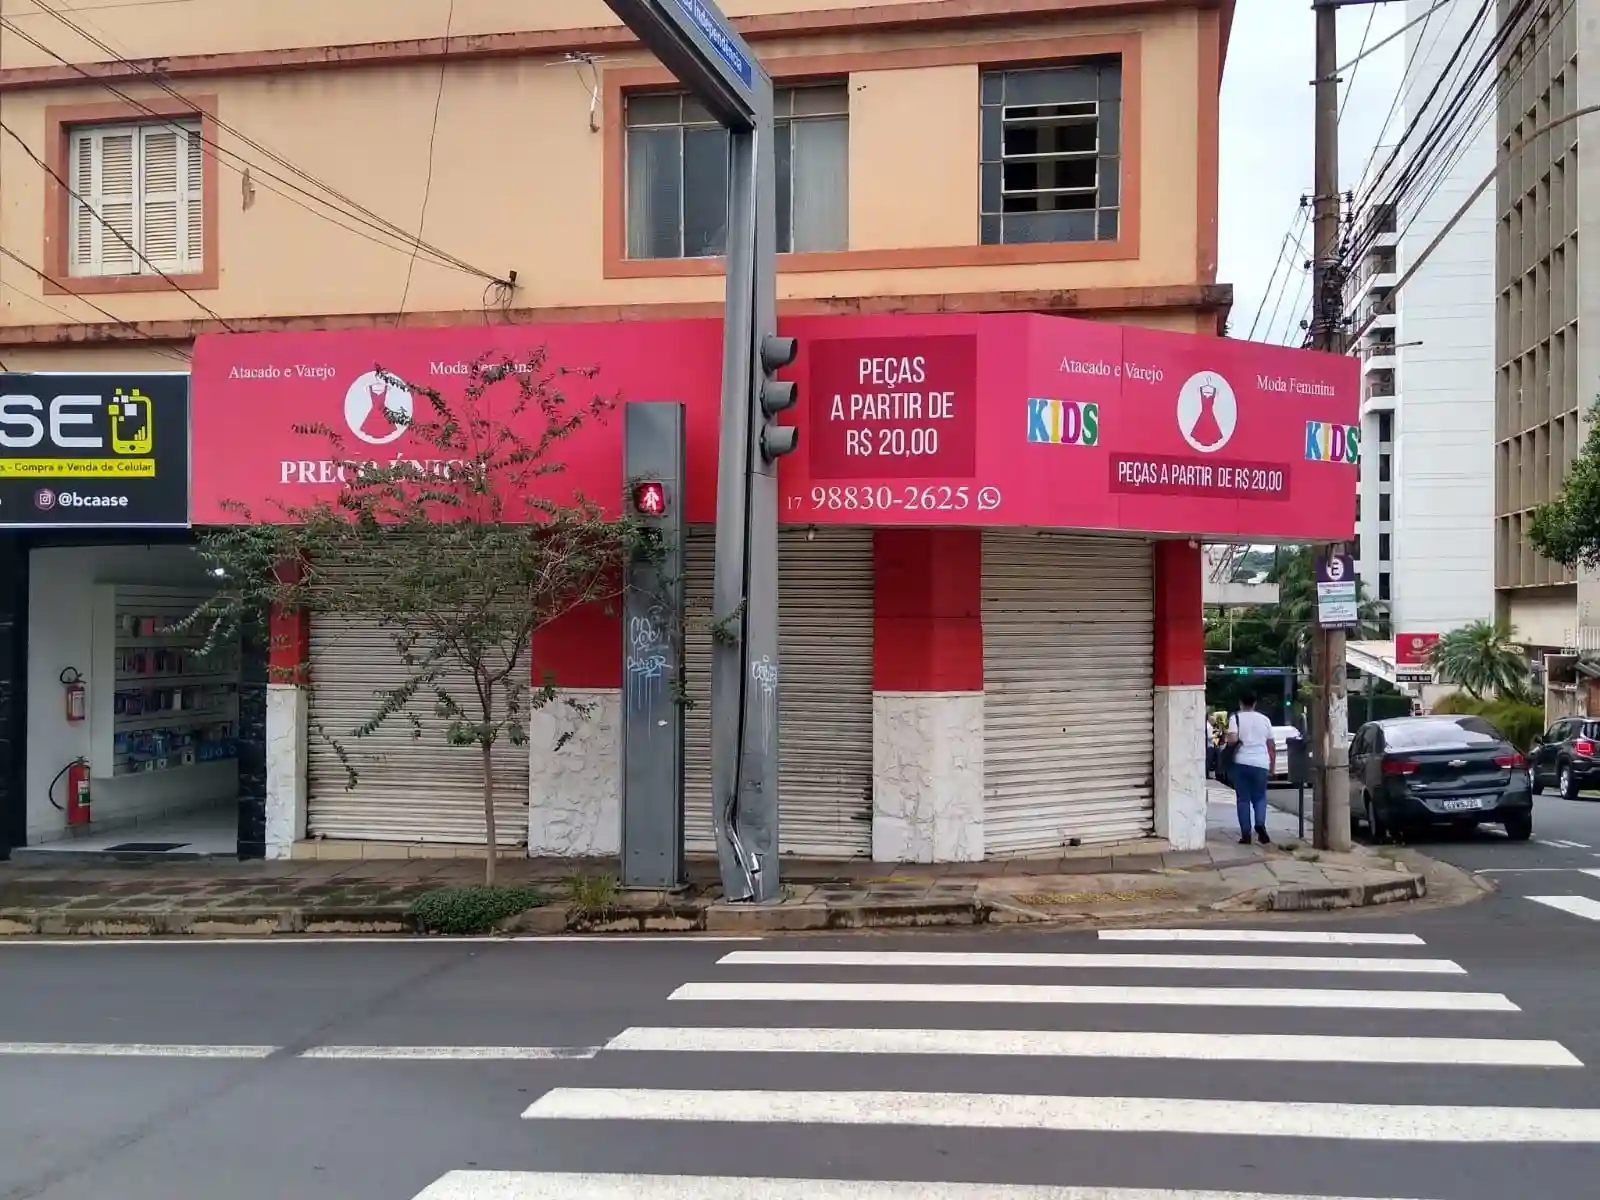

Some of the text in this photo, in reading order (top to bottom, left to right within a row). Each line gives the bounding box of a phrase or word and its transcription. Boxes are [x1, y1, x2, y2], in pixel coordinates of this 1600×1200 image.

[229, 364, 336, 380] Atacado e Varejo
[430, 361, 469, 375] Moda
[859, 356, 926, 389] PEÇAS
[1059, 356, 1164, 385] Atacado e Varejo
[1256, 374, 1336, 396] Moda Feminina
[830, 391, 955, 421] A PARTIR DE
[0, 394, 103, 448] SE
[1028, 398, 1098, 446] KIDS
[846, 428, 938, 458] R$ 20,00
[1305, 421, 1358, 464] KIDS
[14, 462, 55, 473] Compra
[67, 462, 98, 472] Venda
[102, 462, 115, 472] de
[117, 462, 153, 472] Celular
[1118, 461, 1283, 492] PEÇAS A PARTIR DE R$ 20,00
[58, 491, 129, 507] @bcaase
[787, 485, 969, 511] 17 98830-2625
